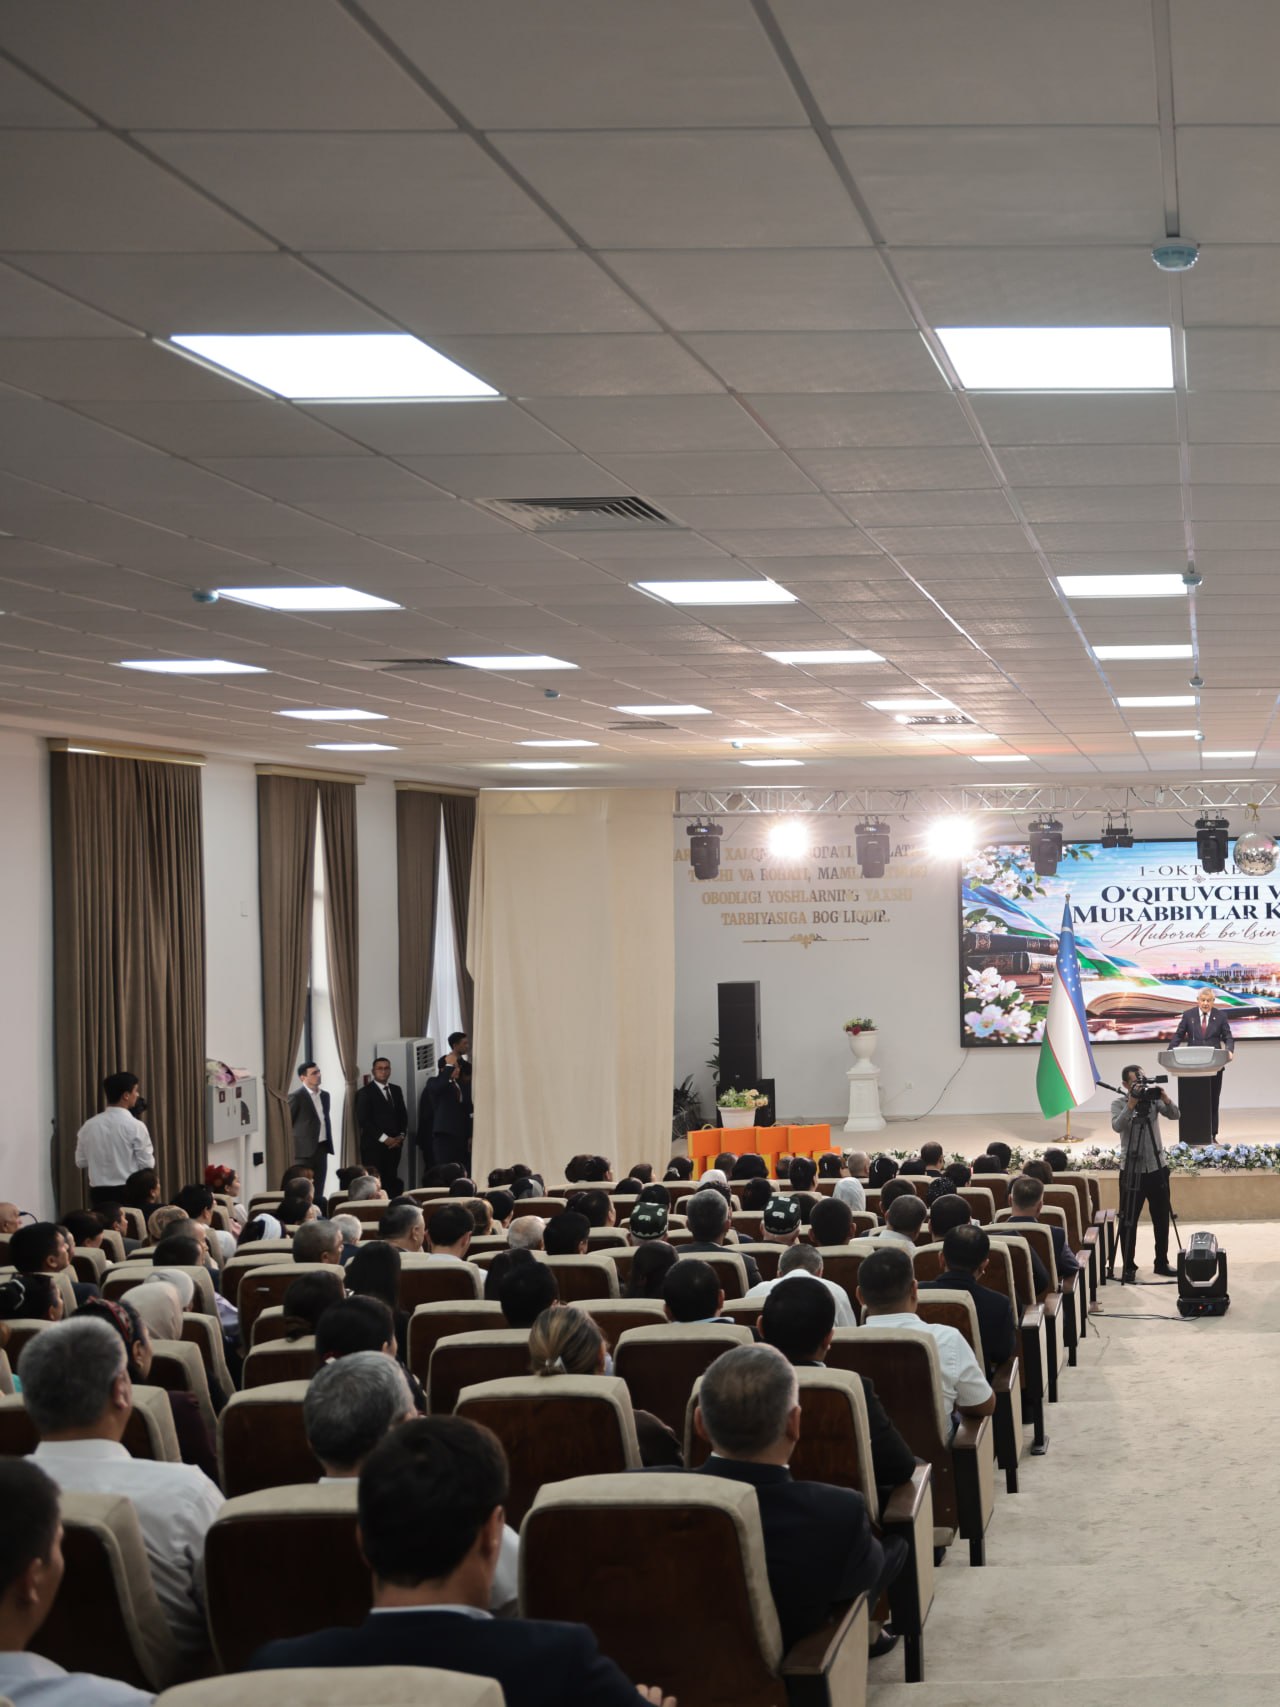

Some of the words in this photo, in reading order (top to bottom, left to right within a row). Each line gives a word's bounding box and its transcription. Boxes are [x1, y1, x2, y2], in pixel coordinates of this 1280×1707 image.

[738, 868, 755, 881] VA
[701, 890, 762, 904] OBODLIGI
[766, 888, 860, 903] YOSHLARNING
[721, 911, 807, 925] TARBIYASIGA
[1072, 904, 1258, 923] MURABBIYLAR
[1100, 921, 1211, 949] Muborak
